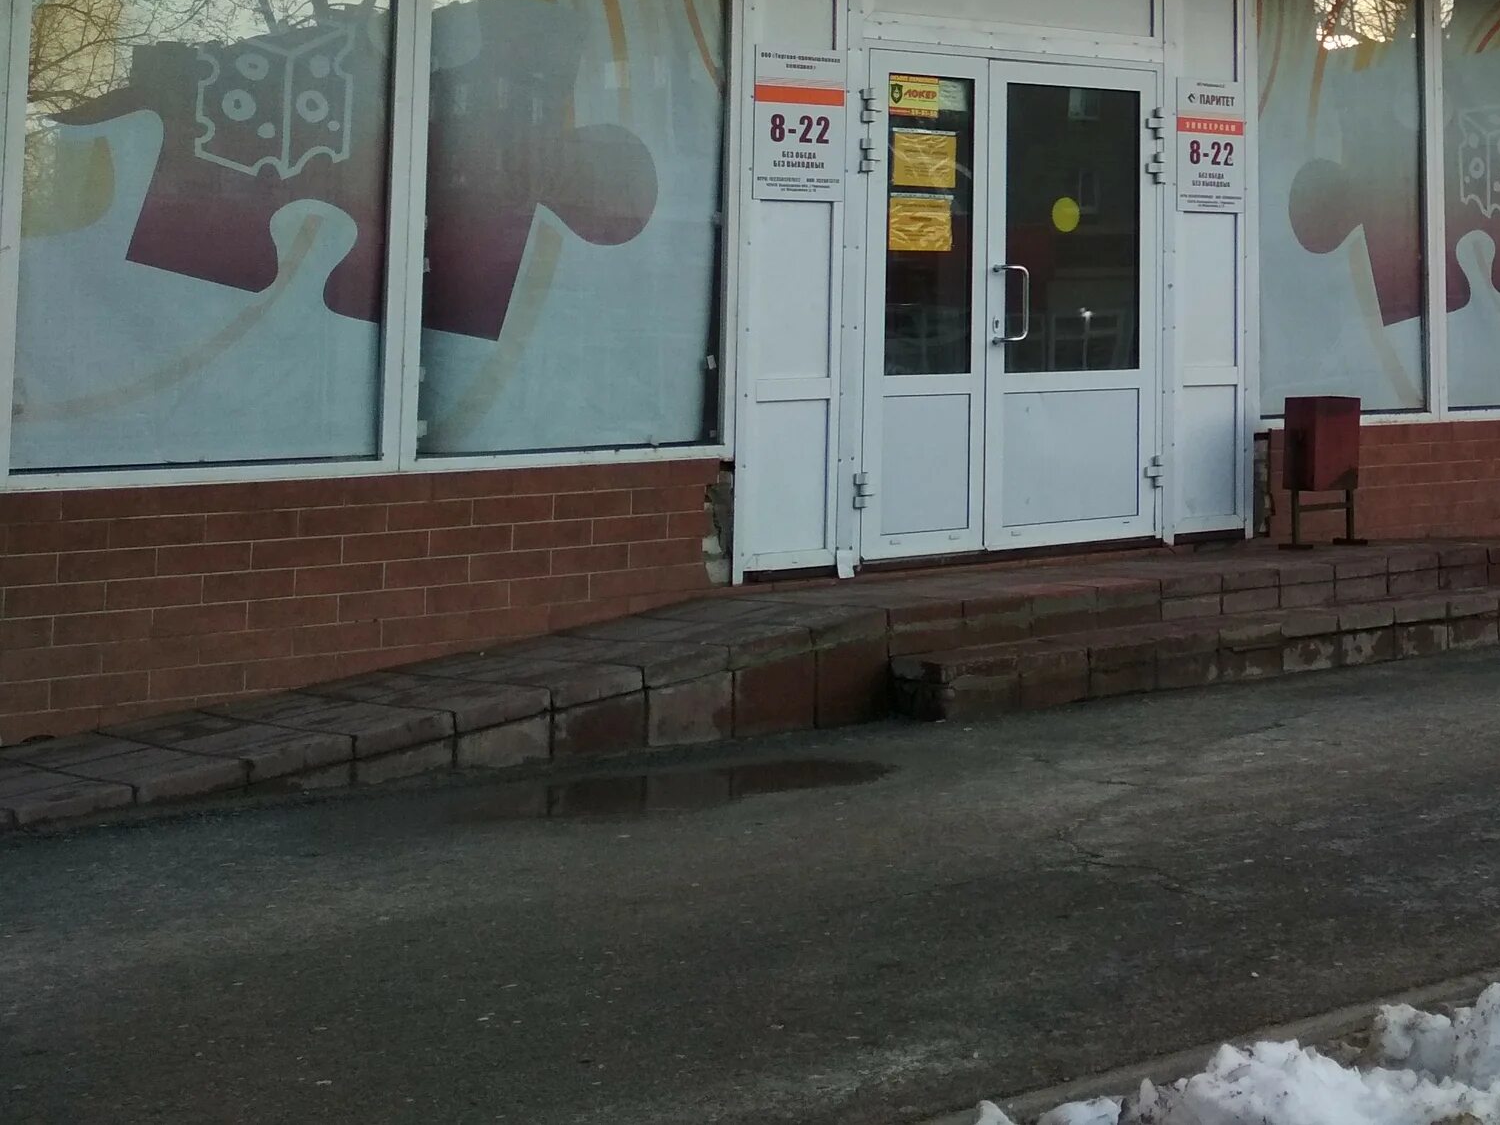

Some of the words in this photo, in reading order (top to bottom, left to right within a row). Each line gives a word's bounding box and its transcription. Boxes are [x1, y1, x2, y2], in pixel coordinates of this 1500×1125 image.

[1199, 93, 1235, 107] ПАРИТЕТ
[770, 113, 831, 145] 8-22
[781, 150, 794, 159] БЕЗ
[795, 151, 817, 160] ОБЕДА
[1189, 139, 1234, 167] 8-22
[773, 160, 785, 168] БЕЗ
[786, 160, 825, 170] ВЫХОДНЫХ
